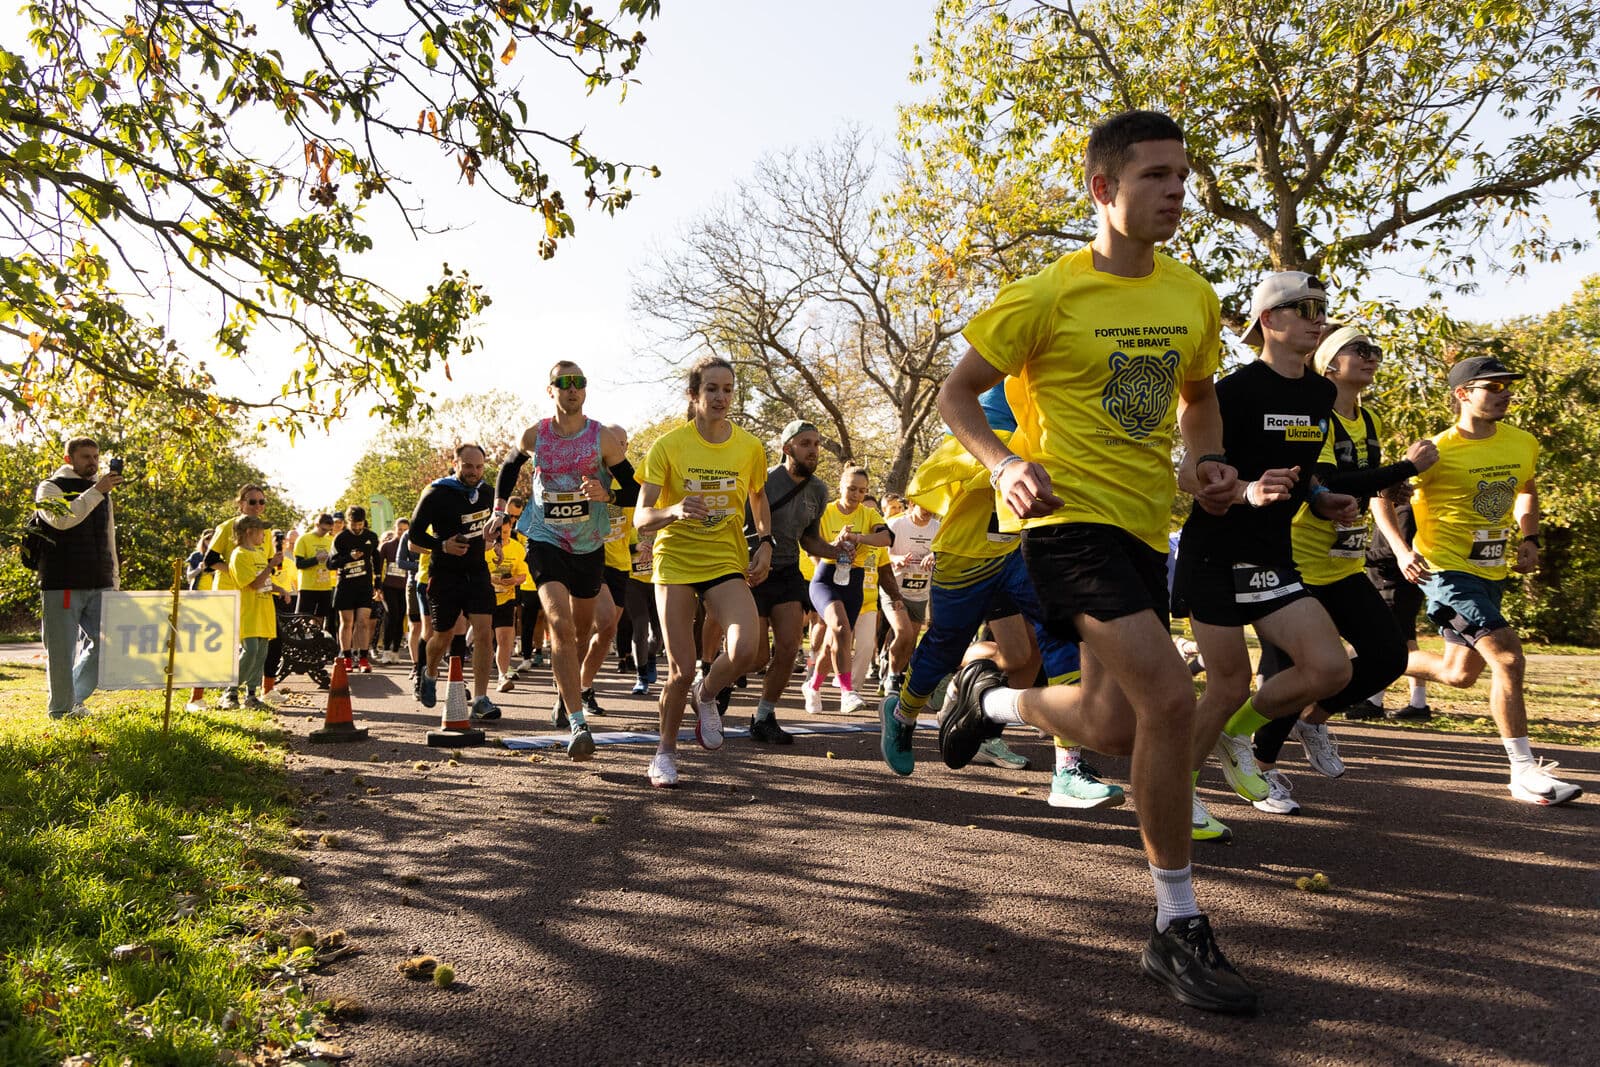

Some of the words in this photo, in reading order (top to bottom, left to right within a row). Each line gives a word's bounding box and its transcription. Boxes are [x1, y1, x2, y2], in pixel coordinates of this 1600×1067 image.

[1095, 327, 1140, 337] FORTUNE
[1143, 326, 1188, 335] FAVOURS
[1116, 339, 1135, 348] THE
[1137, 338, 1171, 347] BRAVE
[1266, 417, 1294, 427] Race
[1296, 417, 1308, 427] for
[1287, 429, 1320, 438] Ukraine
[688, 467, 714, 475] FORTUNE
[703, 494, 729, 508] 69
[550, 505, 583, 517] 402
[1480, 544, 1503, 558] 418
[1249, 570, 1280, 589] 419
